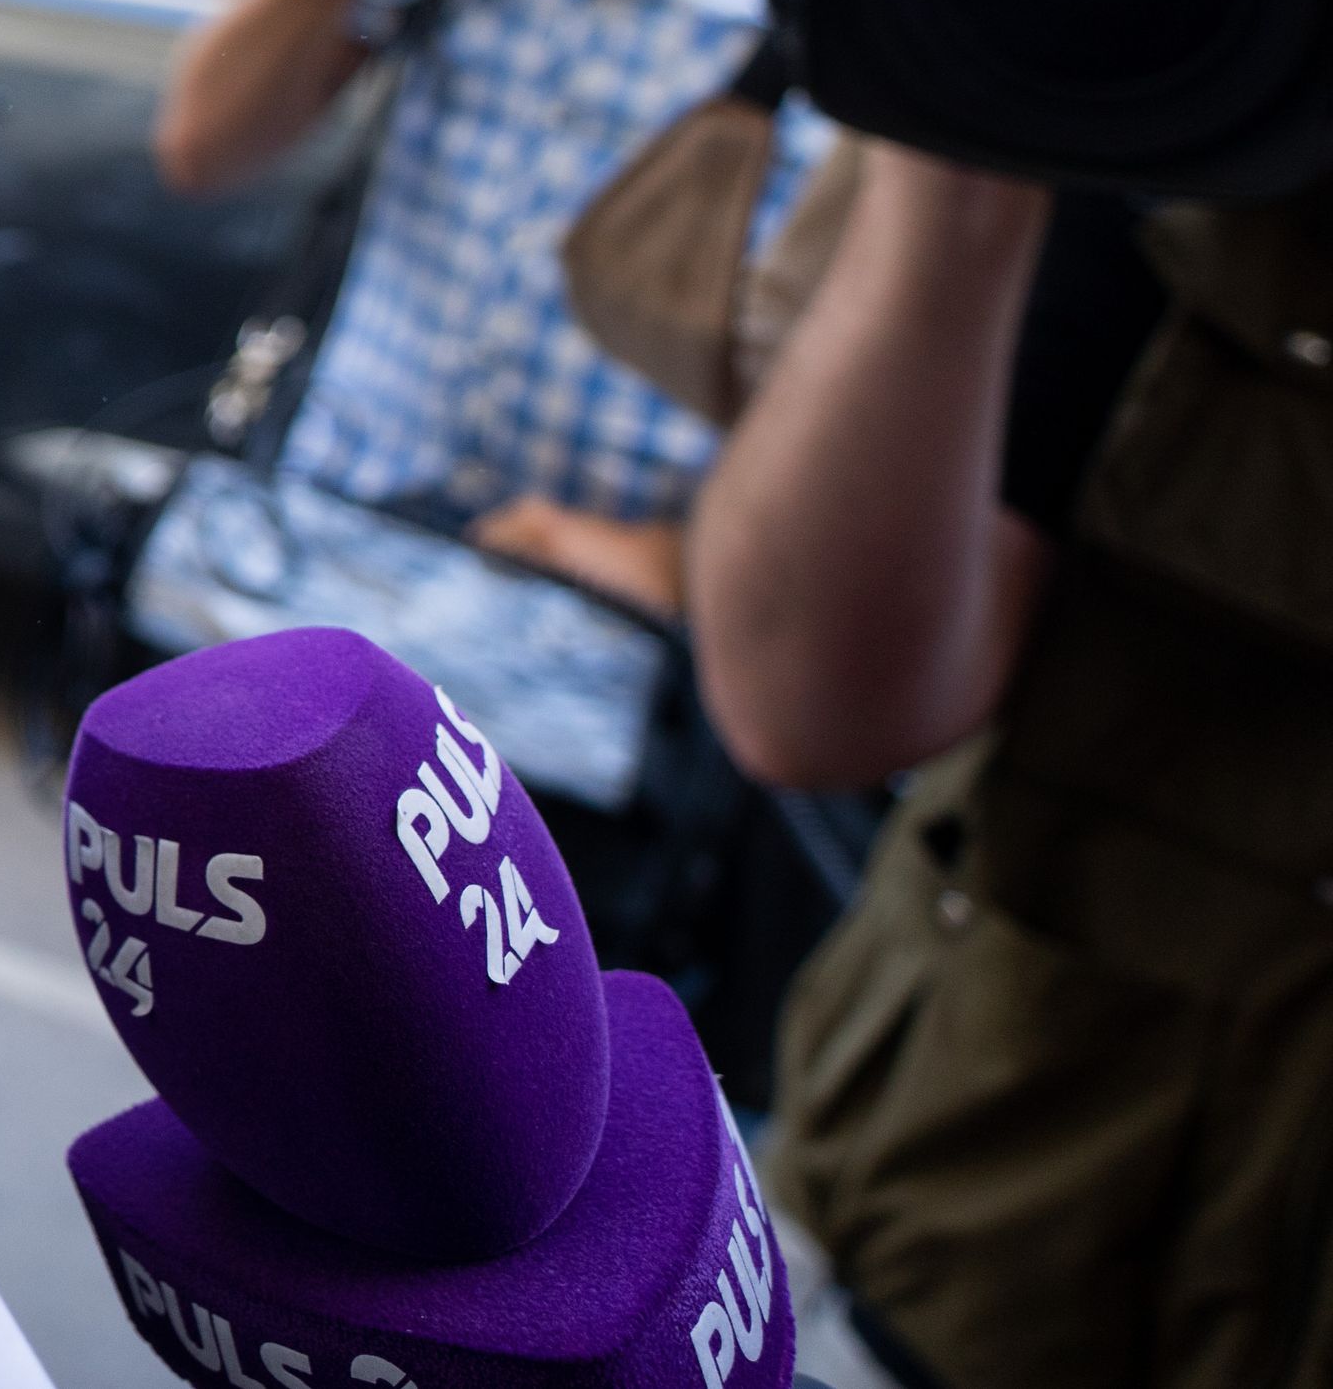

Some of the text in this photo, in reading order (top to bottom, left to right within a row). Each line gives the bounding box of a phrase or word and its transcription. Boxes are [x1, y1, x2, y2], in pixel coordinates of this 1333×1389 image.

[396, 685, 502, 905] PULS
[68, 800, 267, 946] PULS
[459, 855, 561, 986] 24
[81, 897, 154, 1017] 24
